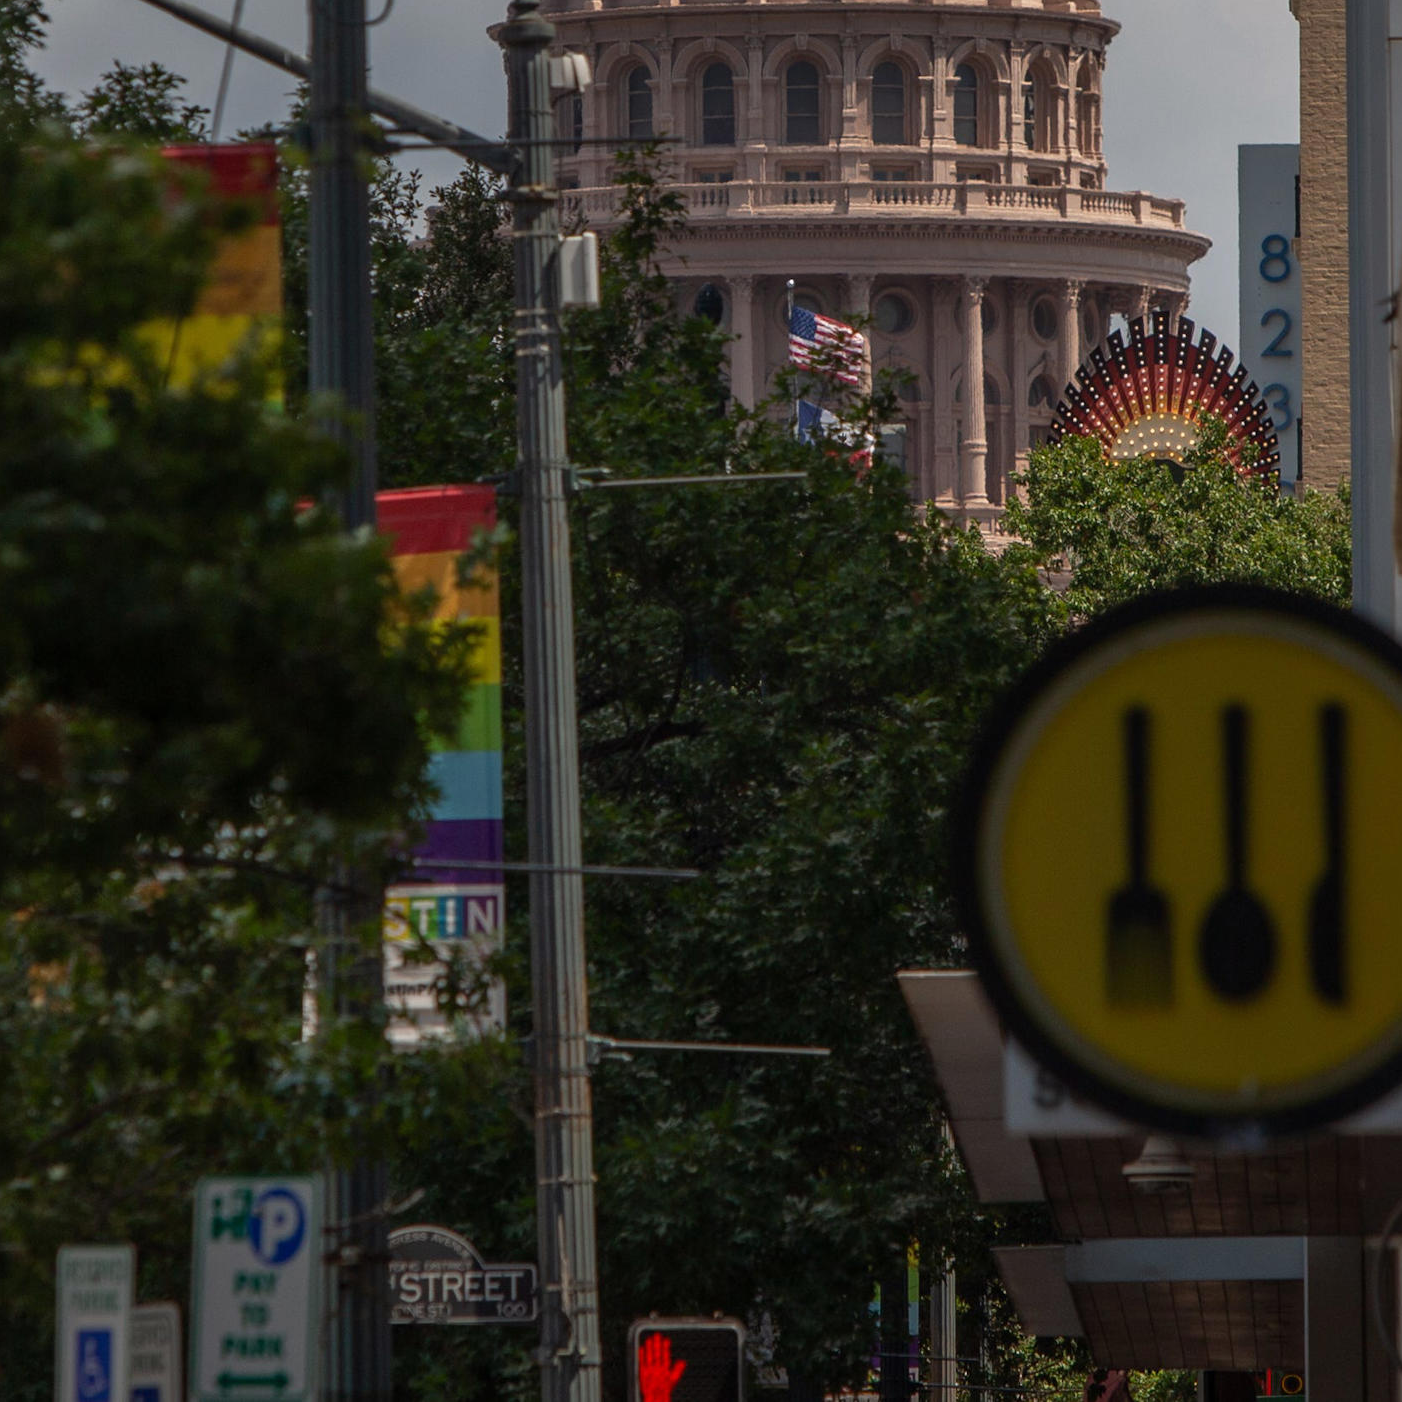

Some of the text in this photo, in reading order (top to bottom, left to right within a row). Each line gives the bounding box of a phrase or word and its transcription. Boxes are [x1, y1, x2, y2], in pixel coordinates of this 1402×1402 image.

[1259, 234, 1294, 432] 823
[232, 1271, 276, 1296] PAY
[399, 1272, 525, 1303] STREET
[239, 1302, 269, 1327] TO
[496, 1302, 528, 1318] 100
[219, 1334, 284, 1360] PARK
